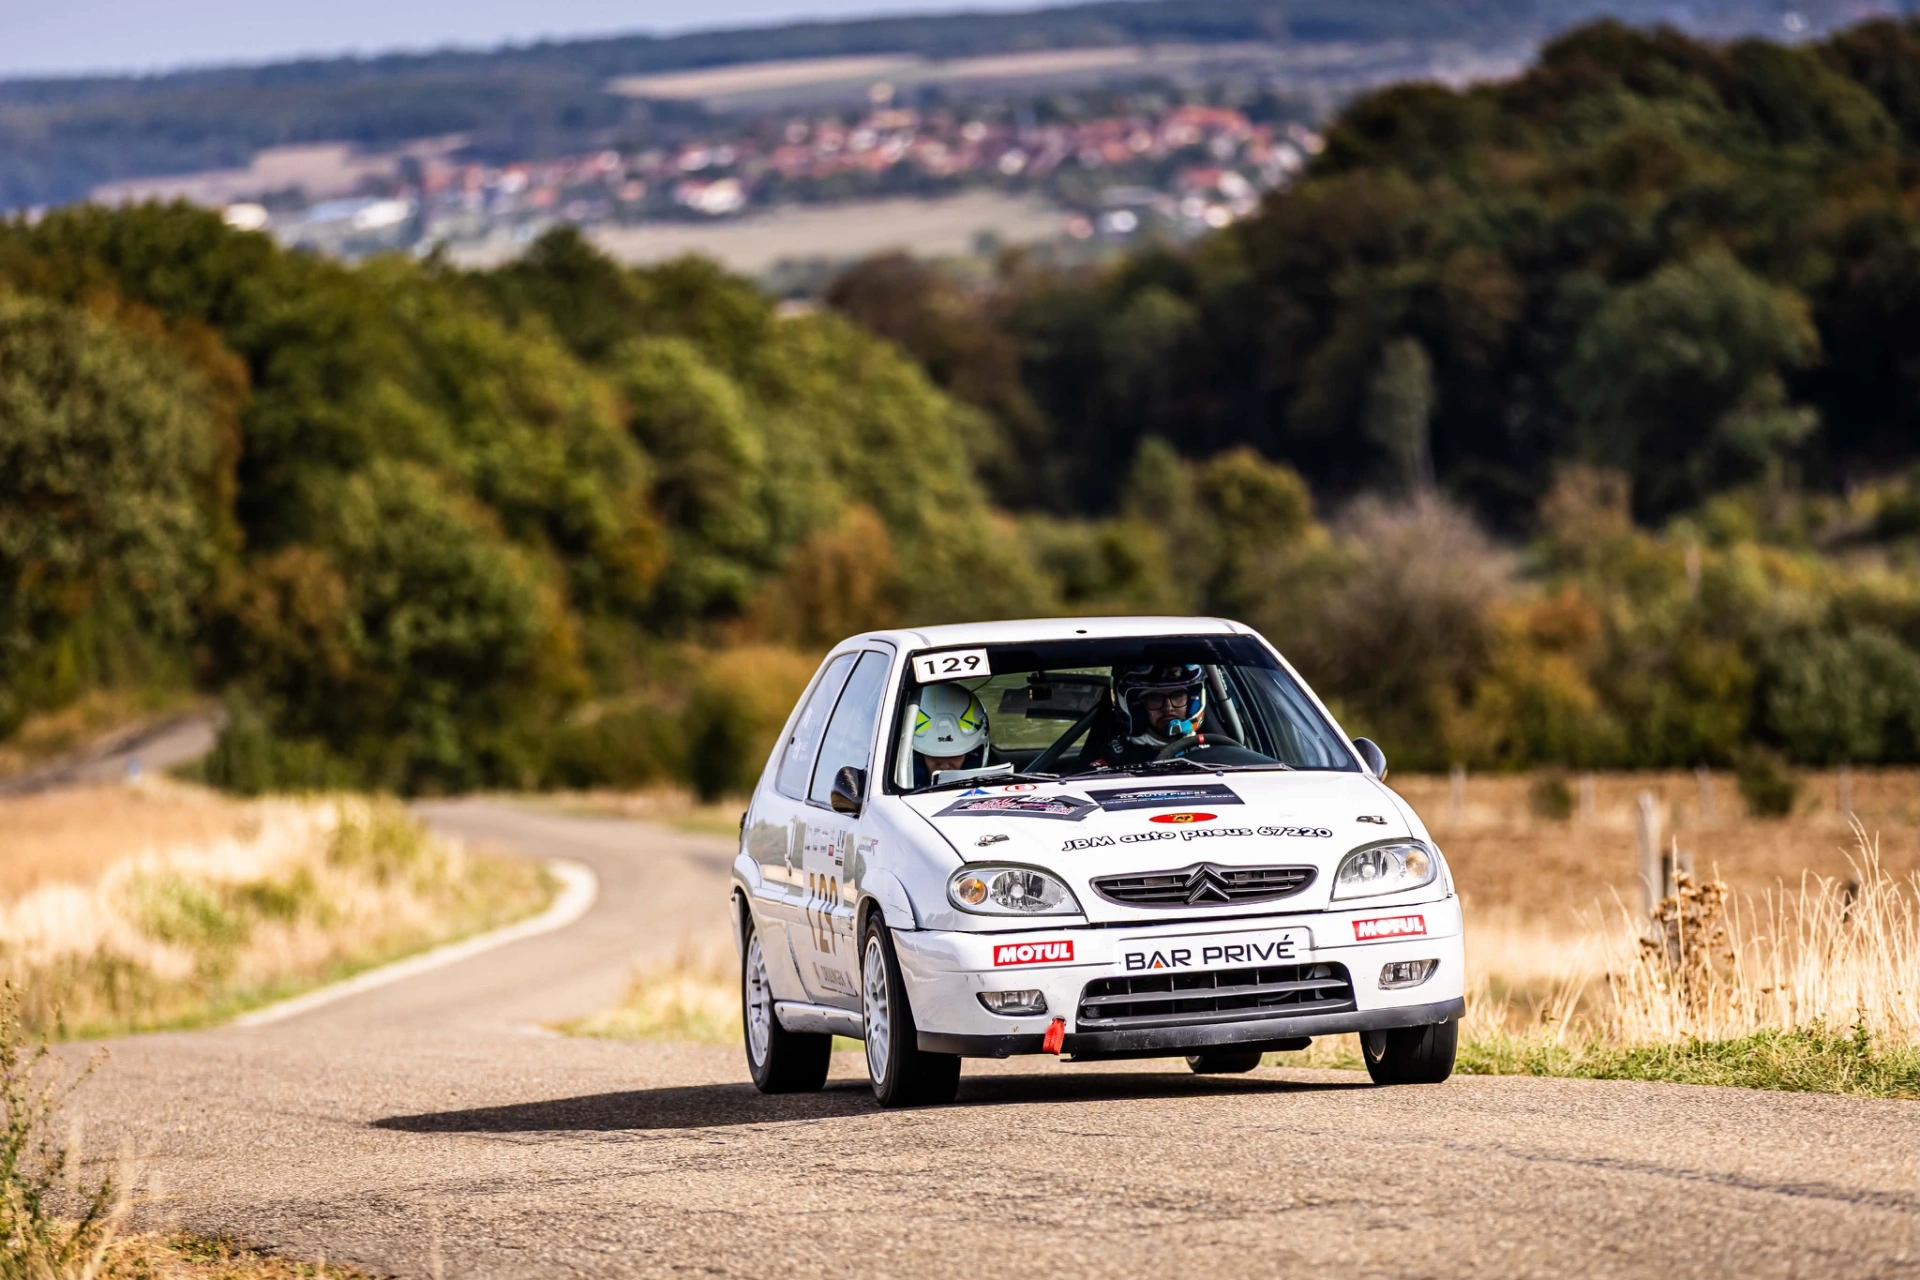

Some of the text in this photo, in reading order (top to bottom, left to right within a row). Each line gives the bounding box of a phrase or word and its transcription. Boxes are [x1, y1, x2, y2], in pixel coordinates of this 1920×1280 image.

[923, 655, 981, 675] 129
[1061, 826, 1333, 852] JBM auto pneus 67220
[806, 872, 838, 957] 129
[1357, 916, 1424, 938] MOTUL
[997, 942, 1072, 963] MOTUL
[1125, 934, 1296, 971] BAR PRIVÉ
